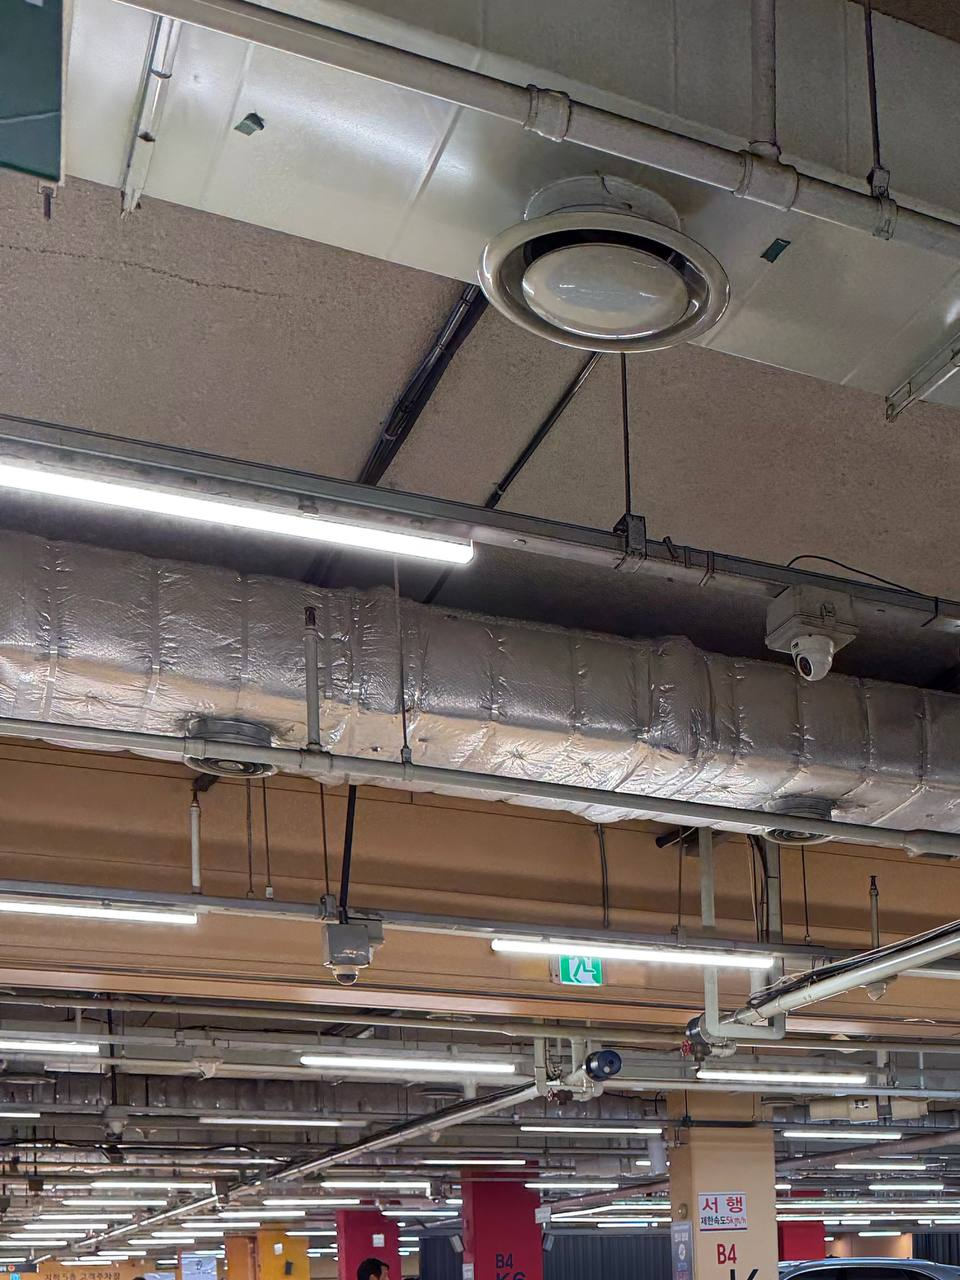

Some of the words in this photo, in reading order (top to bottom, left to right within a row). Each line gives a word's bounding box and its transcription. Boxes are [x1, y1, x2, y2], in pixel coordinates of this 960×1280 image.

[702, 1197, 719, 1214] 서
[726, 1196, 744, 1214] 행
[495, 1253, 514, 1269] B4
[716, 1243, 737, 1265] B4
